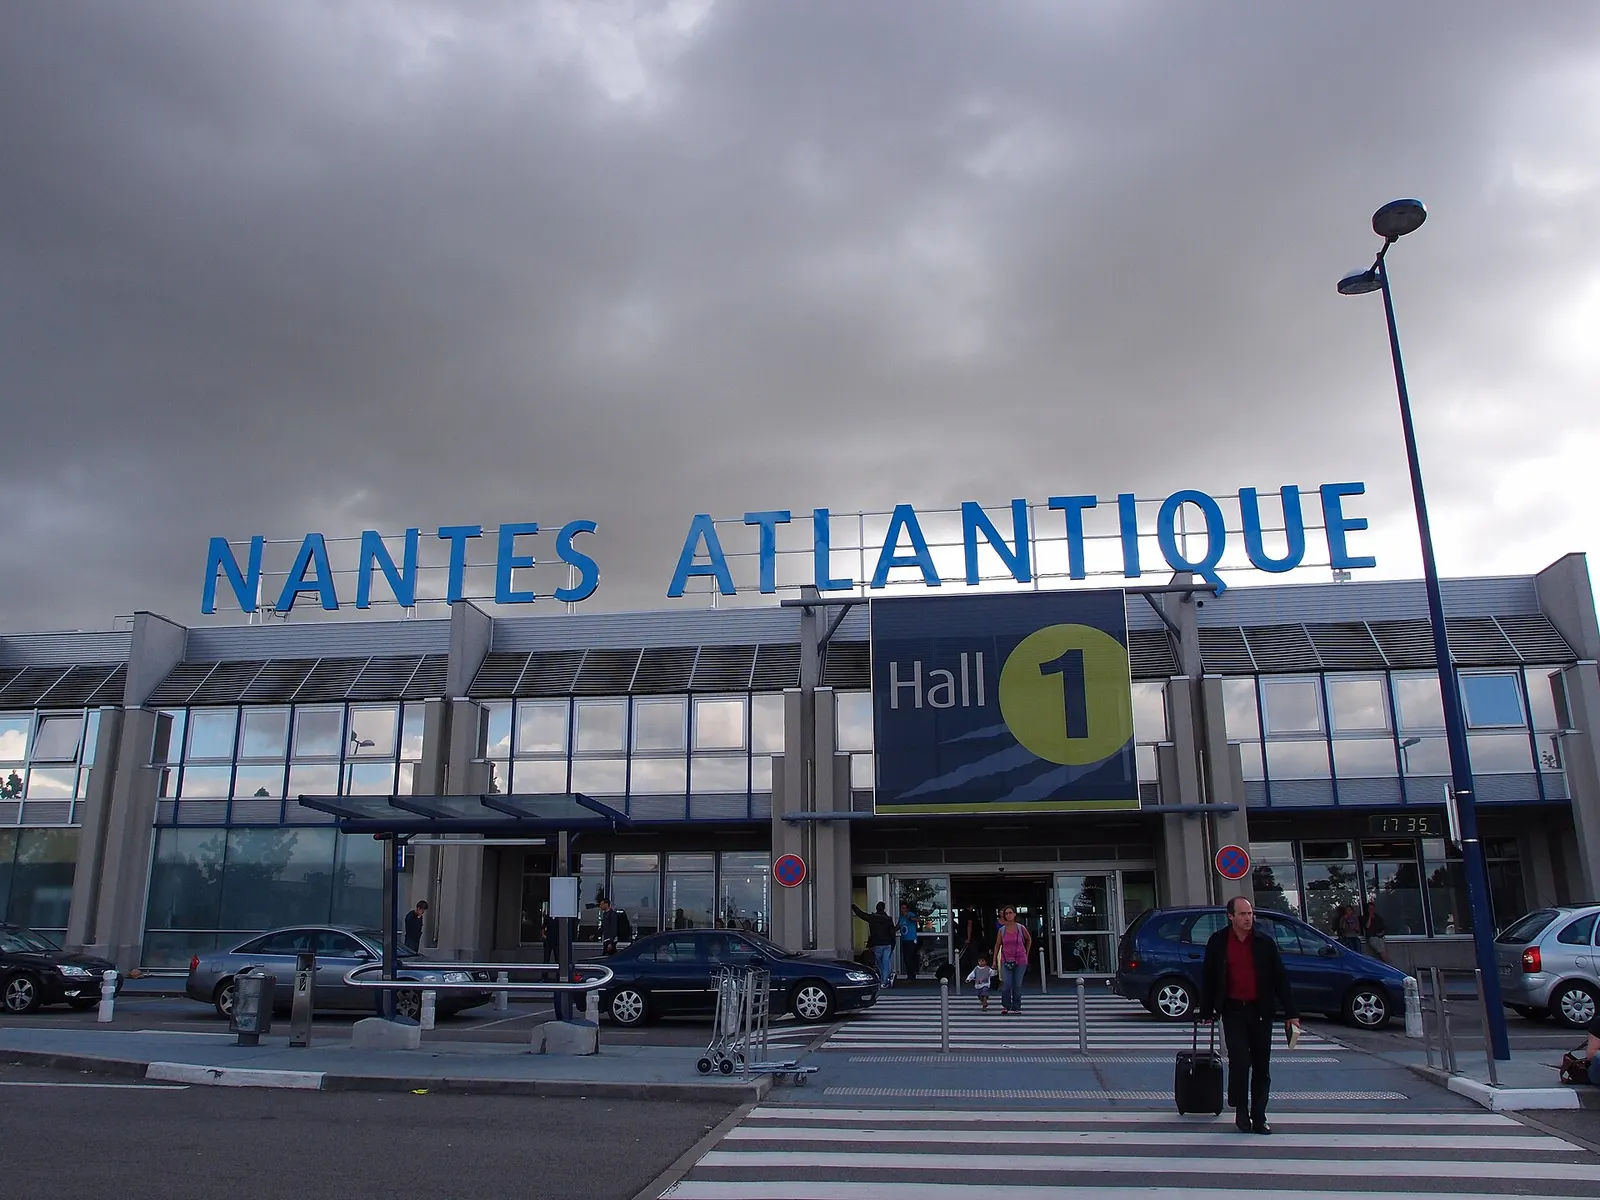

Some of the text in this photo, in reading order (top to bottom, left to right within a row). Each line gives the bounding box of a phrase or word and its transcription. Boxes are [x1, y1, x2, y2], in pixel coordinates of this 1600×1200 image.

[201, 482, 1377, 615] NANTES ATLANTIQUE
[889, 649, 1090, 739] Hall 1
